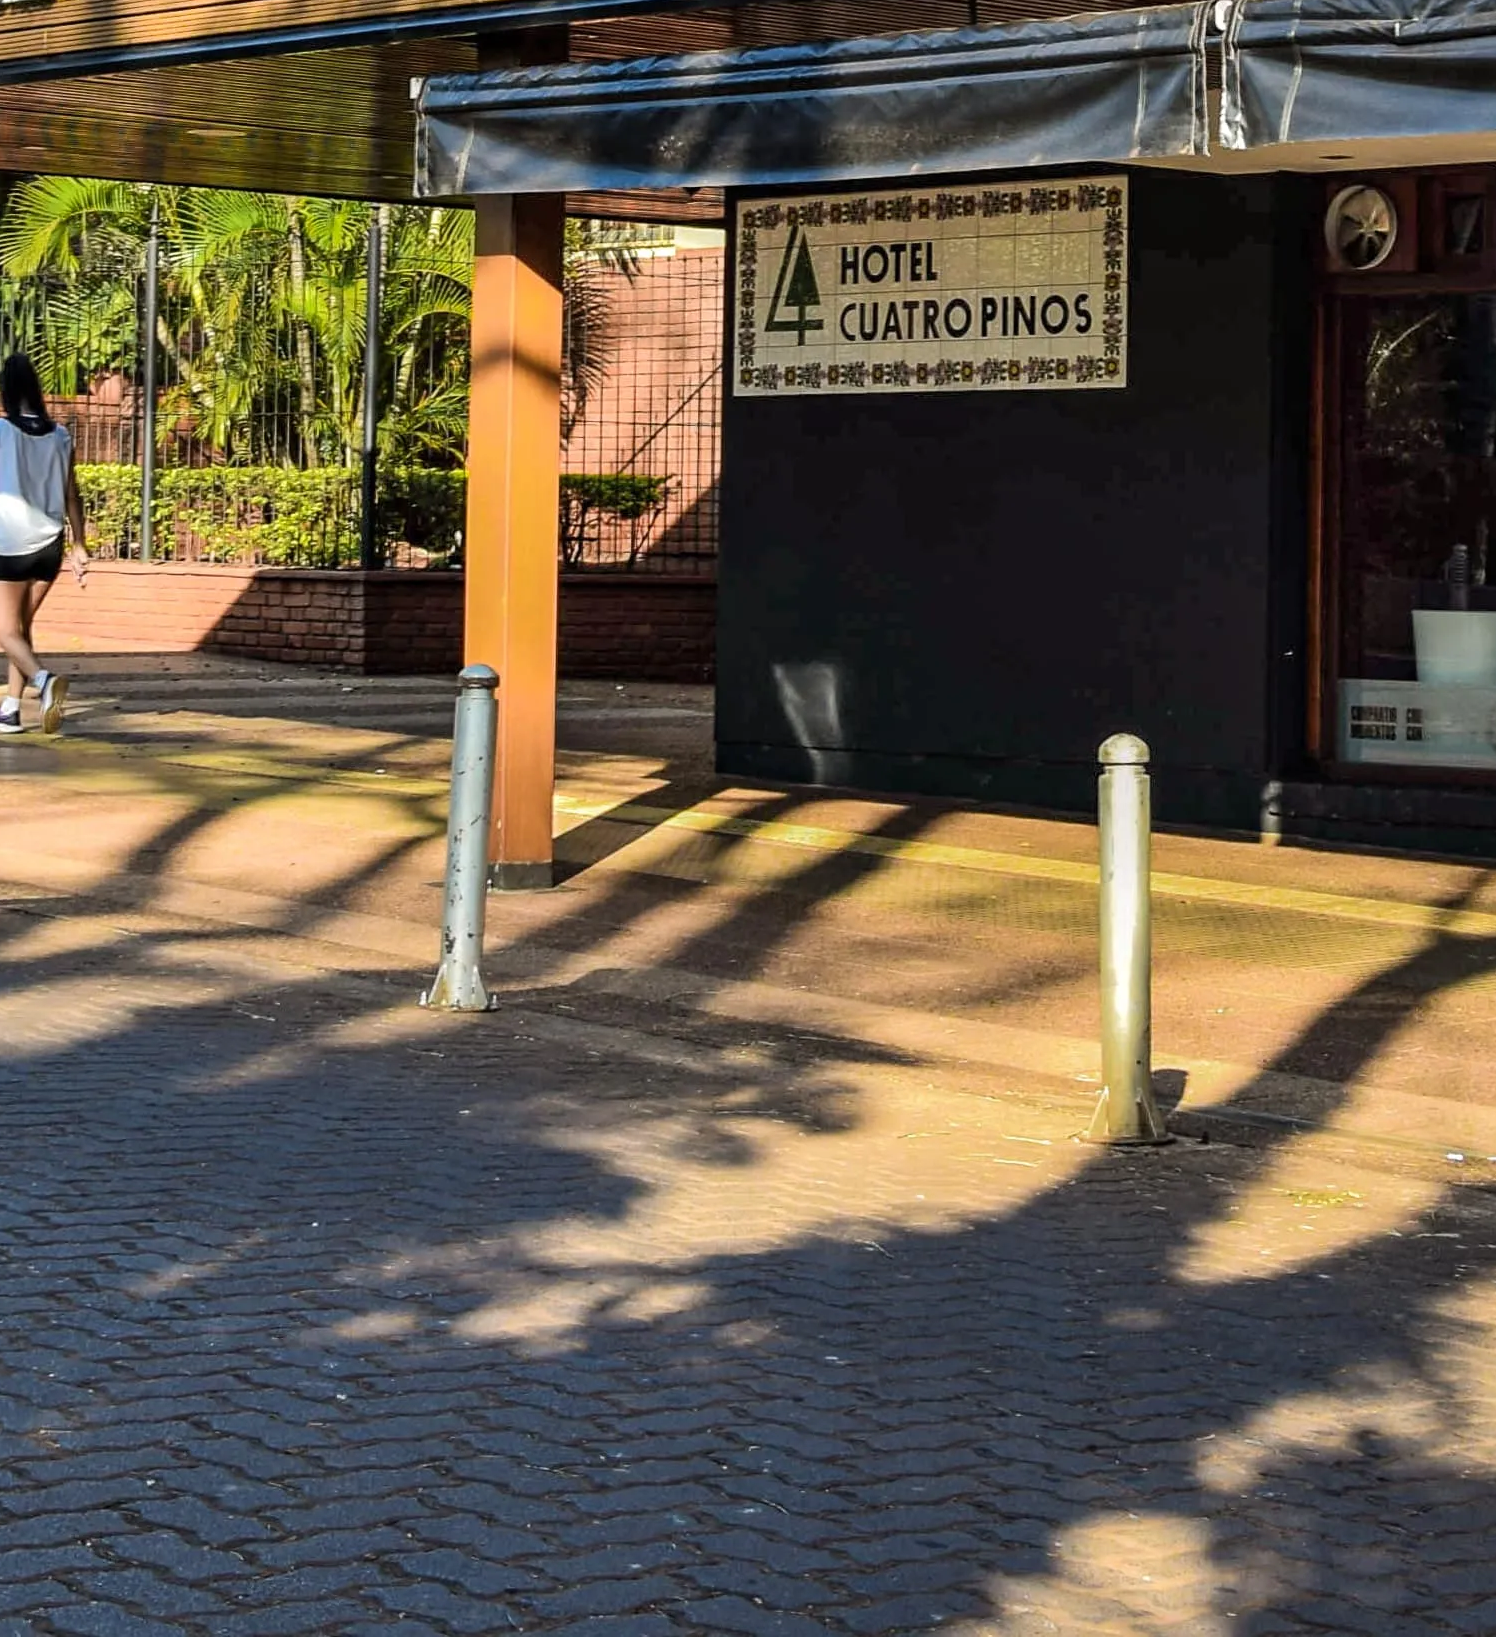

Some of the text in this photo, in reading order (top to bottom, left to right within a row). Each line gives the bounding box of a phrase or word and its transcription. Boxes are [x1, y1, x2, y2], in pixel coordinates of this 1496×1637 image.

[840, 242, 937, 284] HOTEL
[840, 294, 1094, 342] CUATRO PINOS
